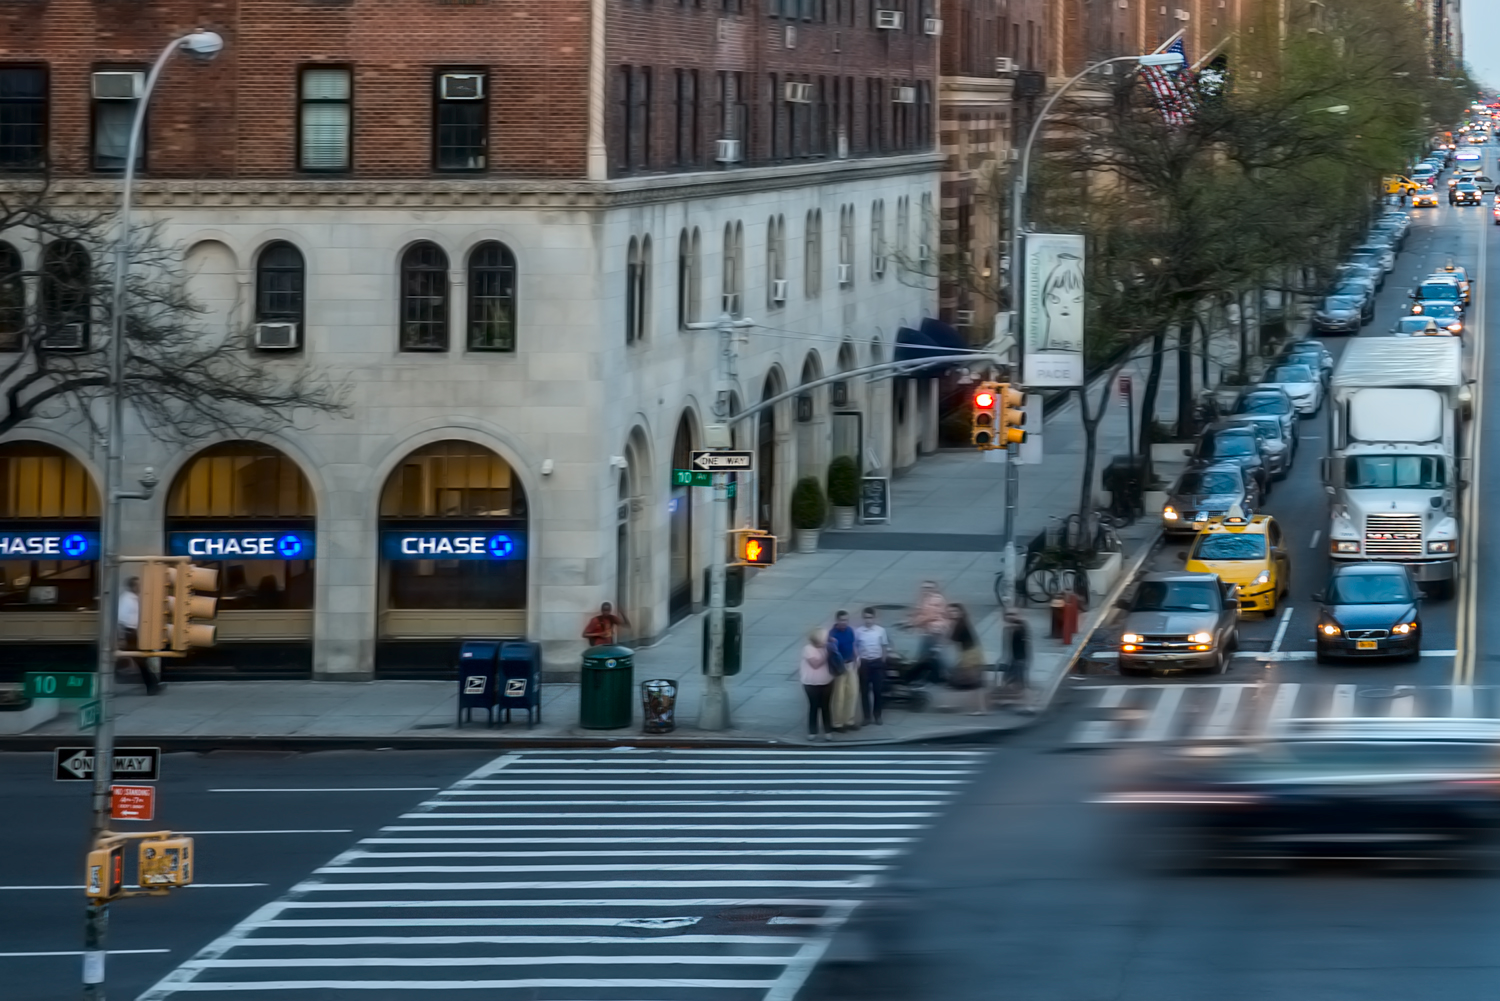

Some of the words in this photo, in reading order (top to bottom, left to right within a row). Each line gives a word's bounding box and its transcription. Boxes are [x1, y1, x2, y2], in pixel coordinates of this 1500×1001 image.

[1037, 369, 1071, 379] PACE
[702, 457, 719, 465] ONE
[726, 457, 746, 465] WAY
[677, 471, 692, 484] 10
[188, 537, 275, 555] CHASE
[401, 537, 487, 554] CHASE
[33, 675, 57, 694] 10
[70, 758, 93, 771] ON
[114, 758, 147, 770] WAY
